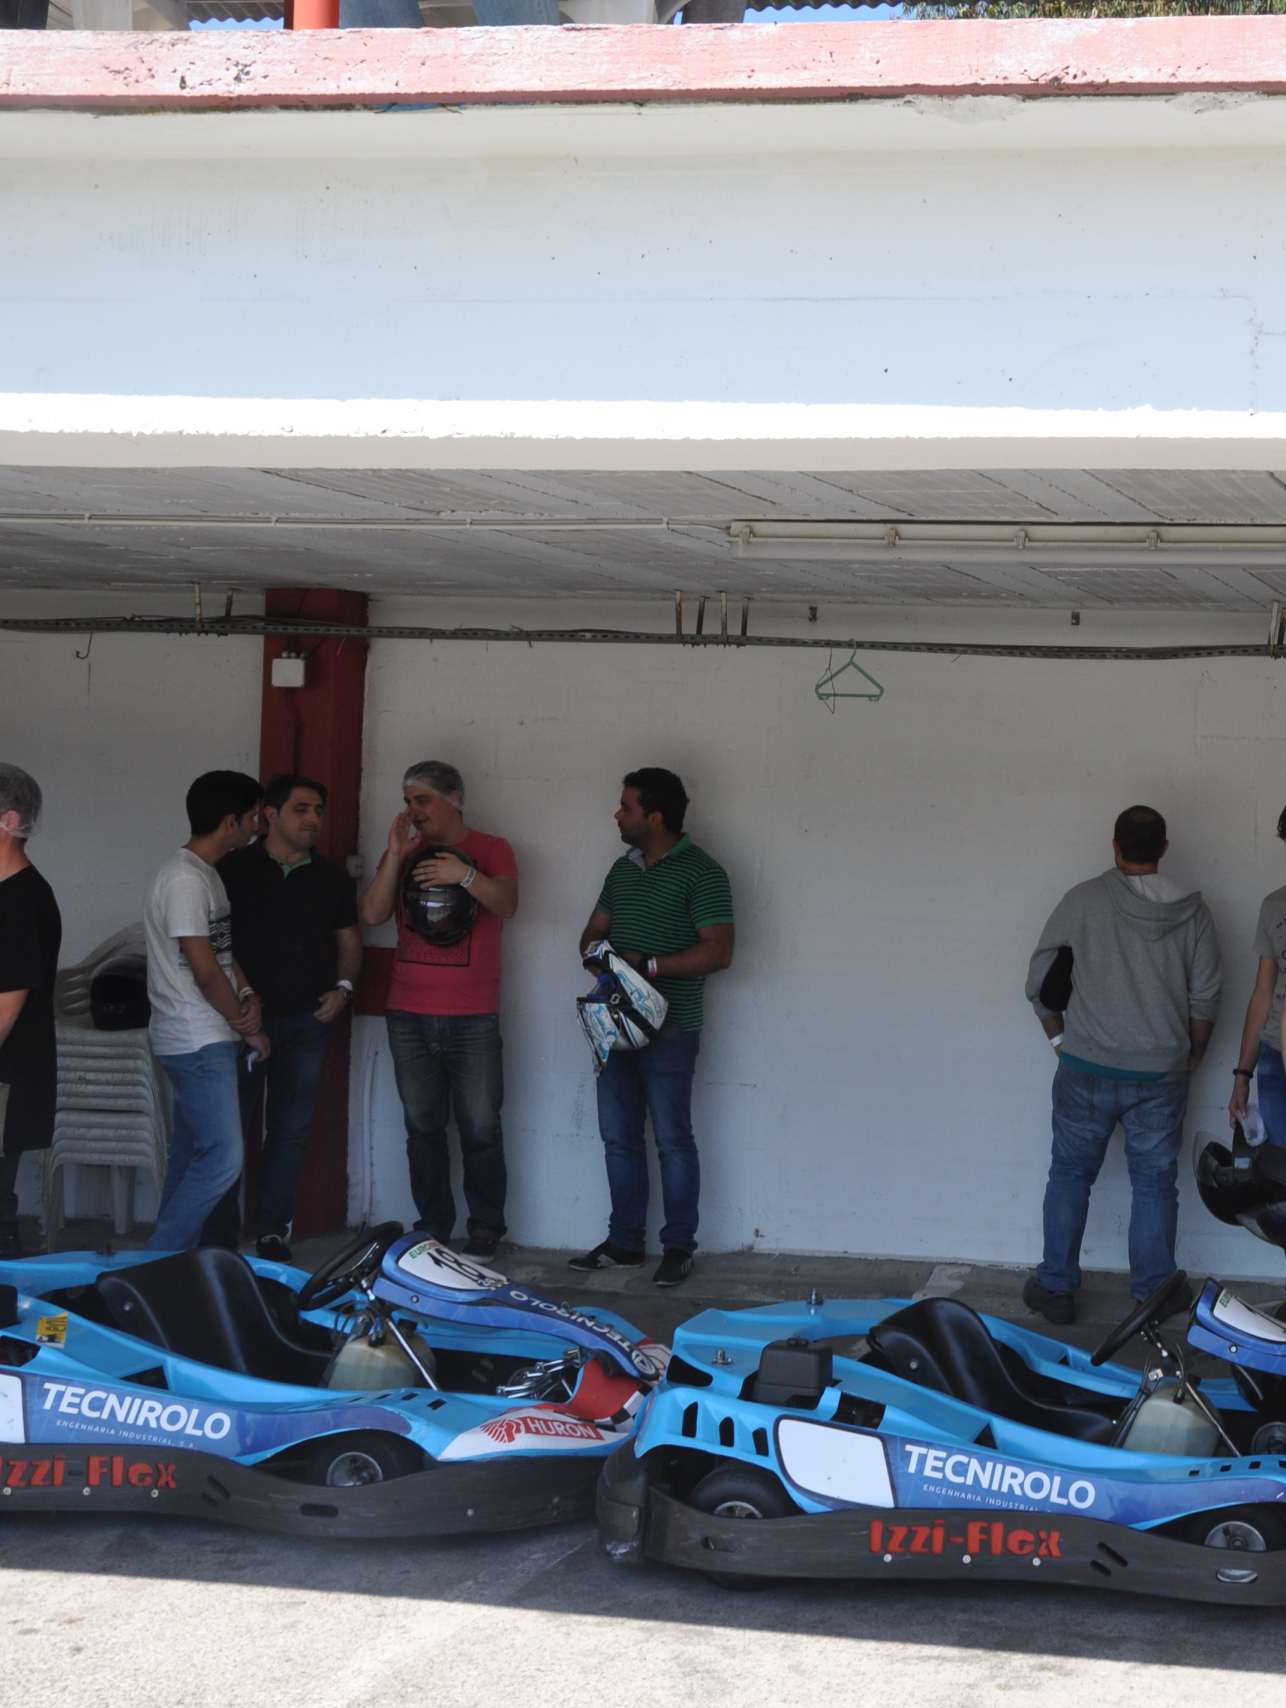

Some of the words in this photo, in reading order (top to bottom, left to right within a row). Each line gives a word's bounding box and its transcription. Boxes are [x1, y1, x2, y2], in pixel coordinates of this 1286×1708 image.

[509, 1289, 632, 1352] TECNIROLO
[42, 1381, 232, 1440] TECNIROLO
[56, 1418, 116, 1436] ENGENHARIA
[526, 1417, 597, 1440] HURON
[904, 1444, 1096, 1510] TECNIROLO
[923, 1484, 982, 1503] ENGENHARIA
[869, 1518, 1063, 1559] Izzi-Flex
